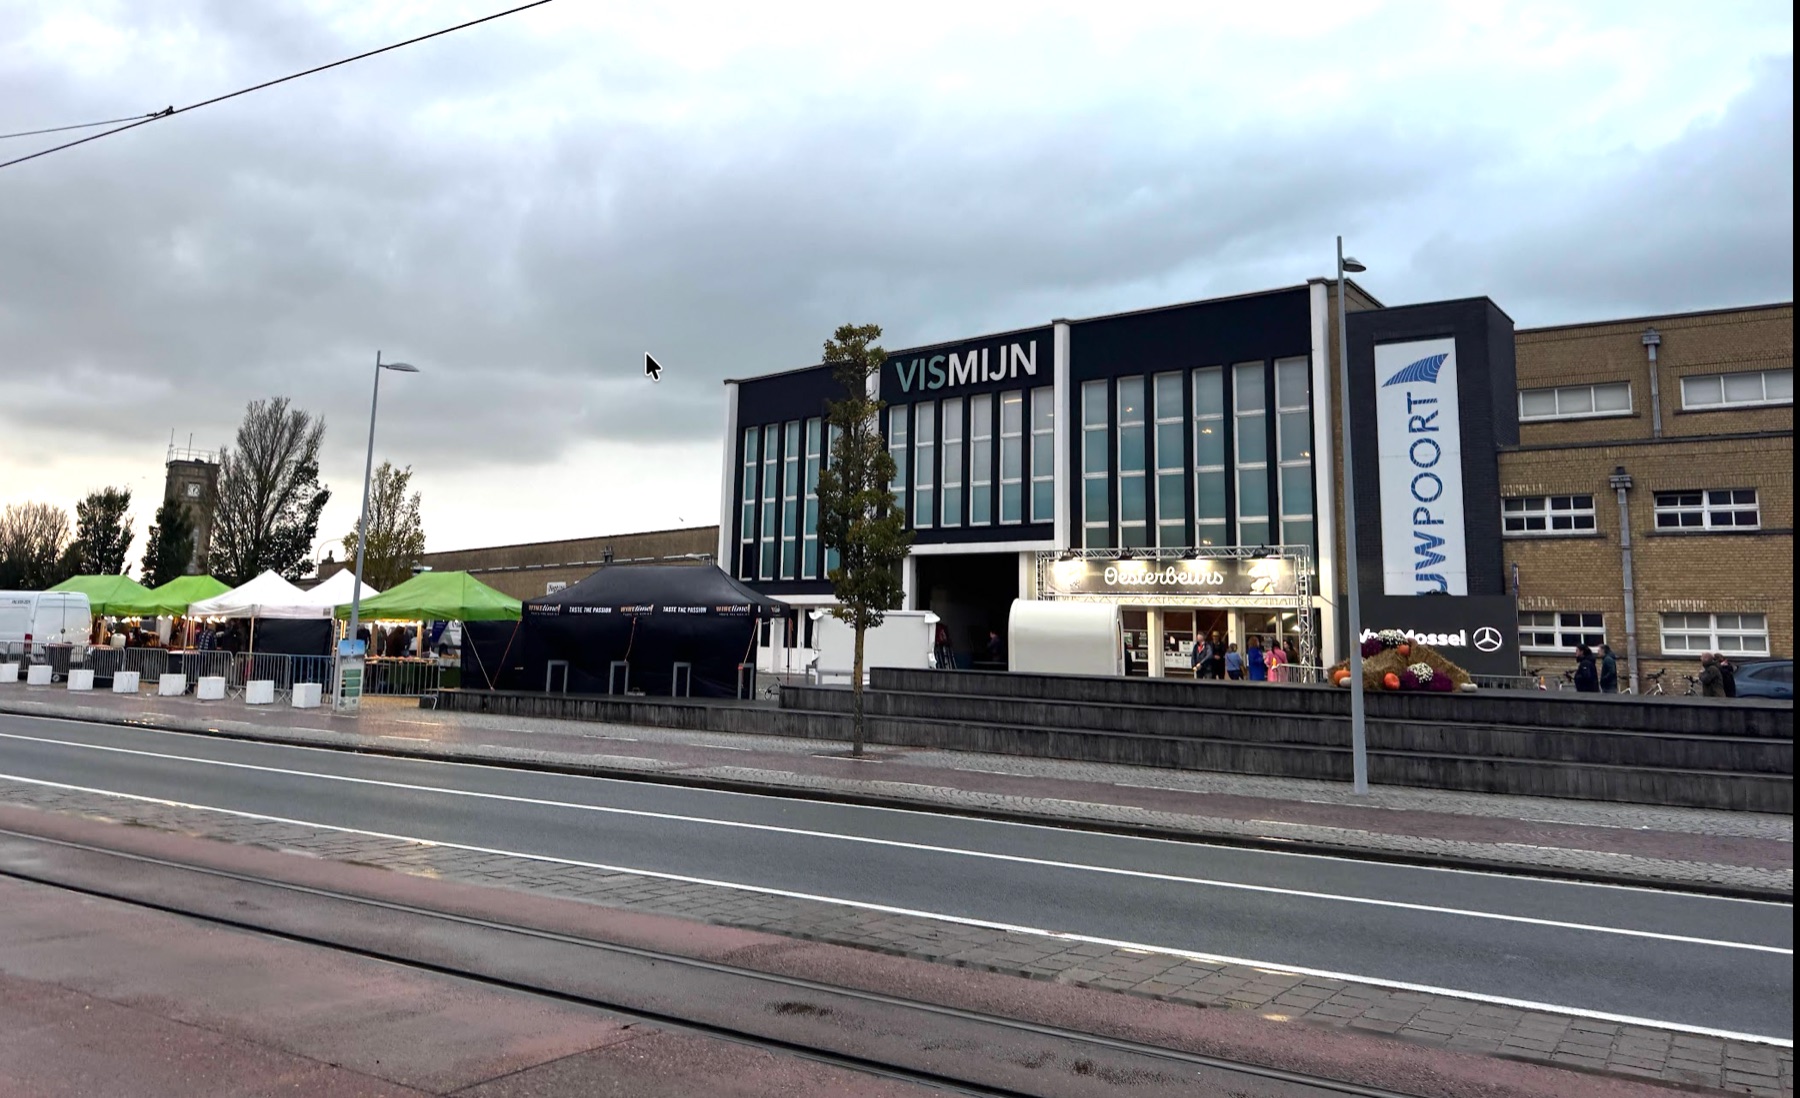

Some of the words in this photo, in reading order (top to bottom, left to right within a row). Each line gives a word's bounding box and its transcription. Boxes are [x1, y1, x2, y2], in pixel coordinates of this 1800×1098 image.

[896, 340, 1037, 393] VISMIJN
[1104, 566, 1224, 586] Oesterbeurs
[1396, 629, 1467, 646] Mossel
